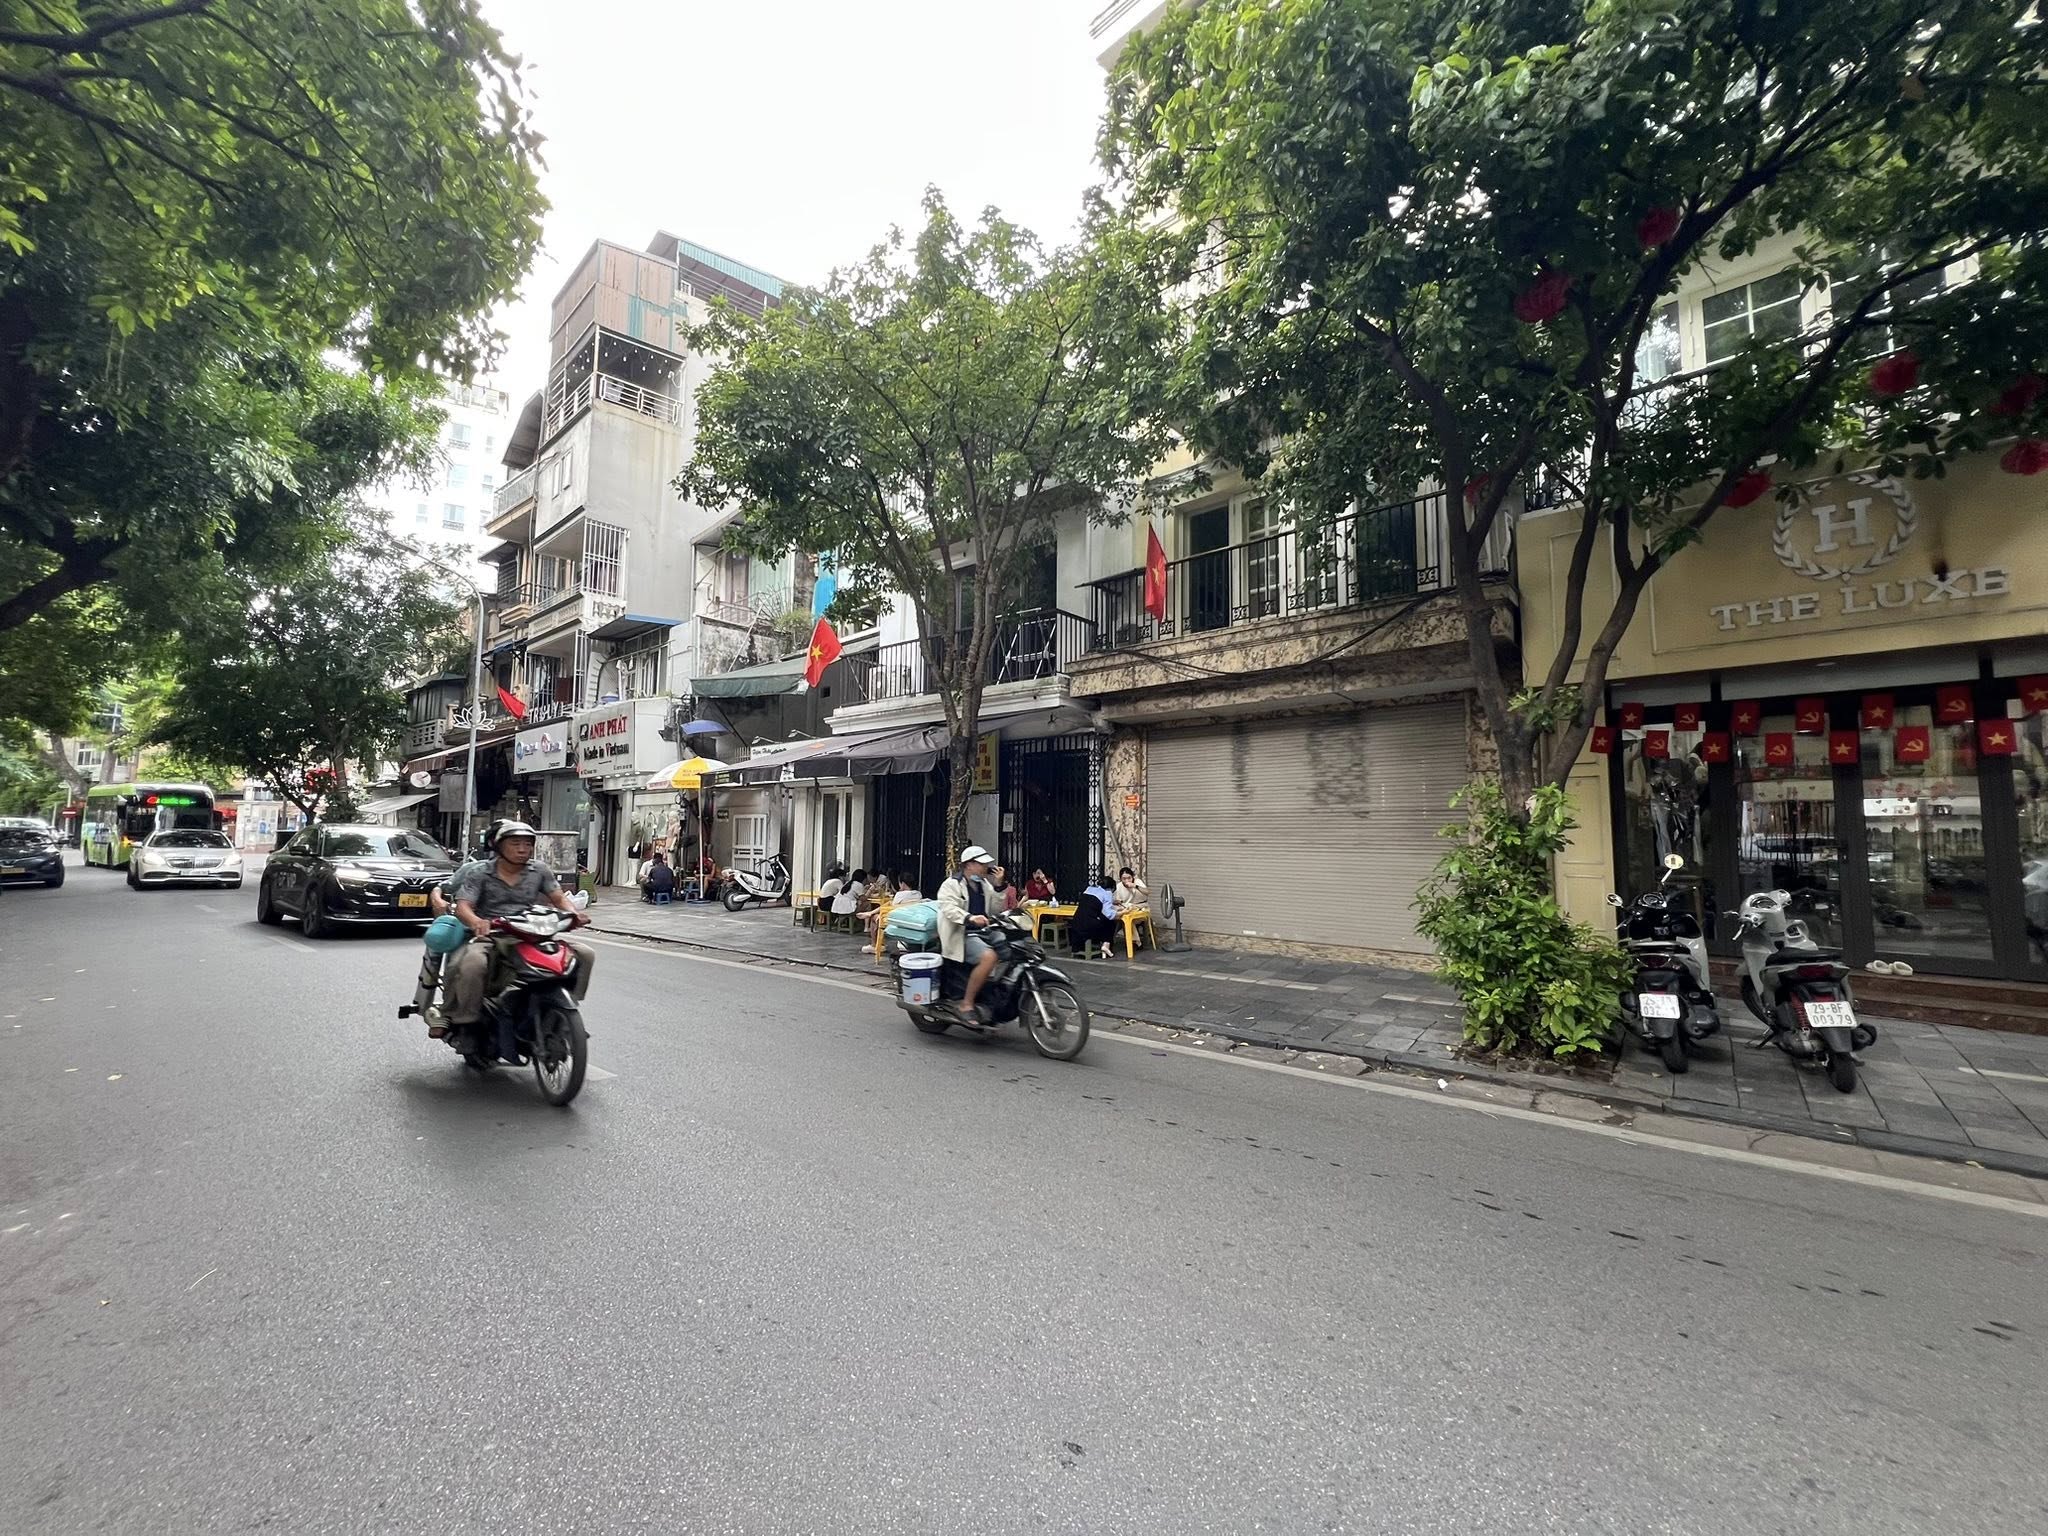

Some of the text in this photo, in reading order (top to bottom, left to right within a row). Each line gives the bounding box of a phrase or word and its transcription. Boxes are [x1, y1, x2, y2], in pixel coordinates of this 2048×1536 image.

[1811, 497, 1875, 553] H
[1710, 565, 2010, 631] THE LUXE
[589, 714, 628, 740] ANH PHÁT
[583, 742, 630, 761] Made in Vietnam
